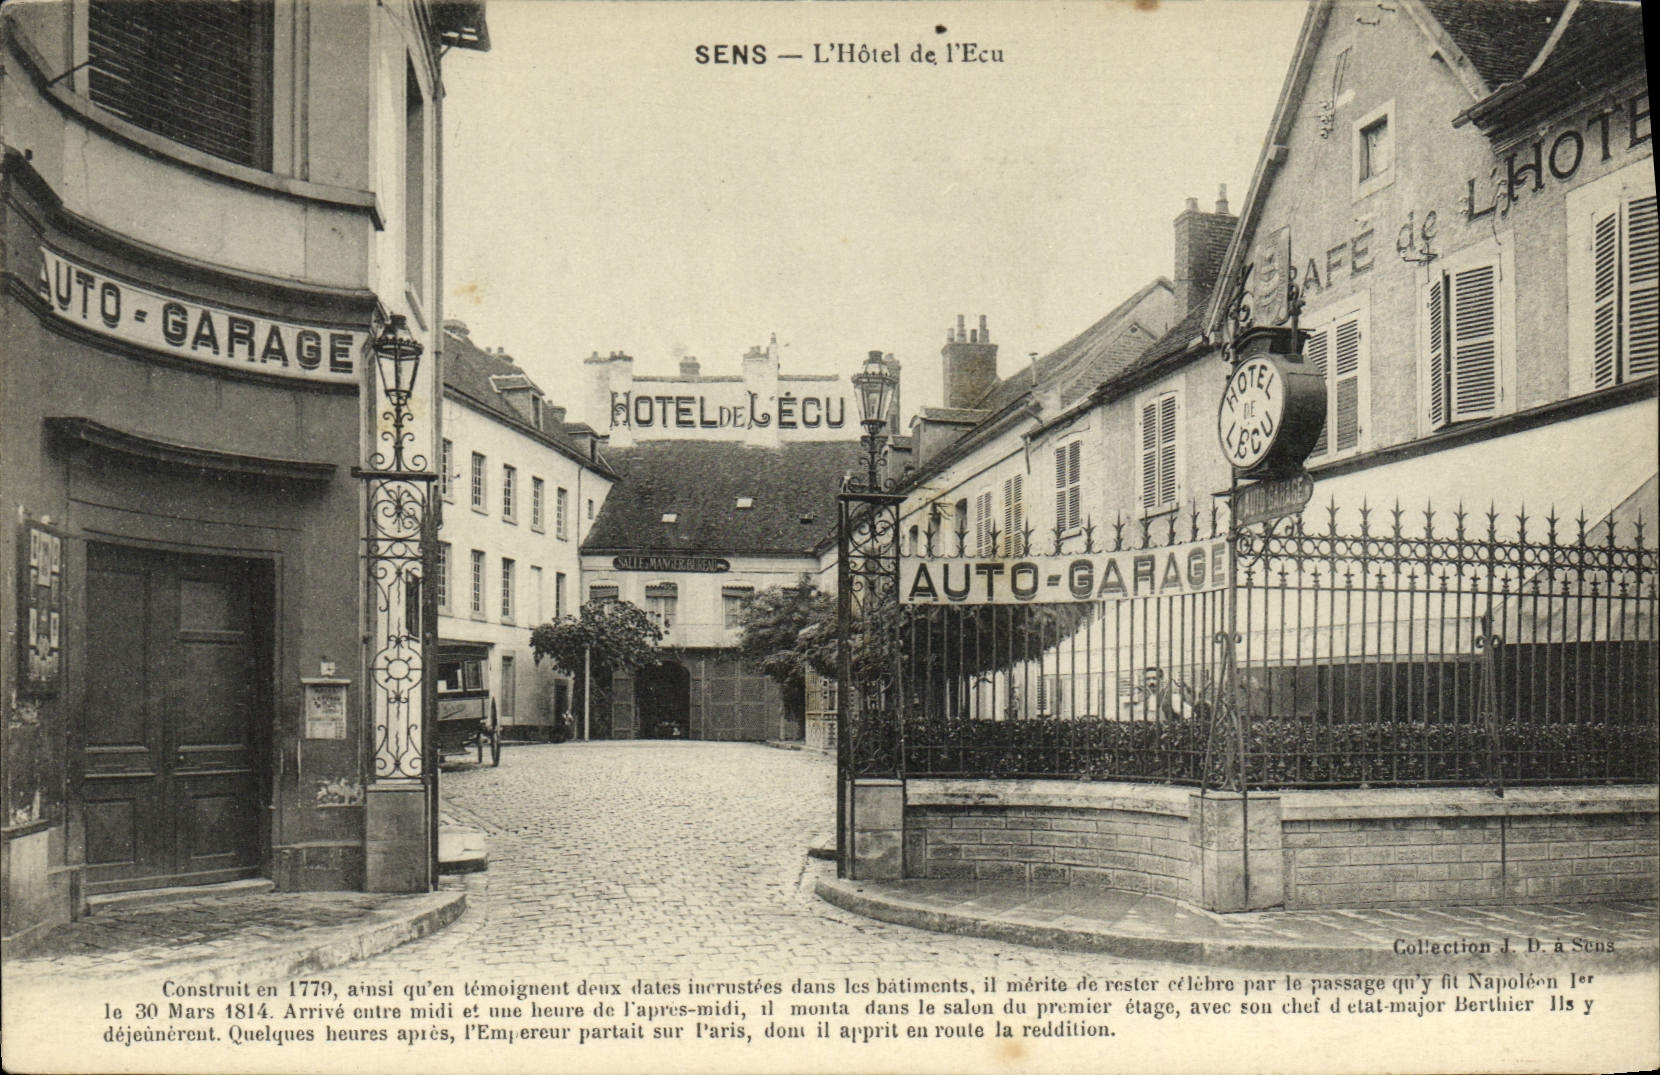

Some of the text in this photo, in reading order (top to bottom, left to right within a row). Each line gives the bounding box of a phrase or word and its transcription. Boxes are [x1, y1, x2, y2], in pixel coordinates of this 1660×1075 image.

[1225, 364, 1274, 413] HOTEL
[609, 390, 719, 430] HOTEL
[719, 405, 745, 429] DE
[1243, 400, 1257, 420] DE
